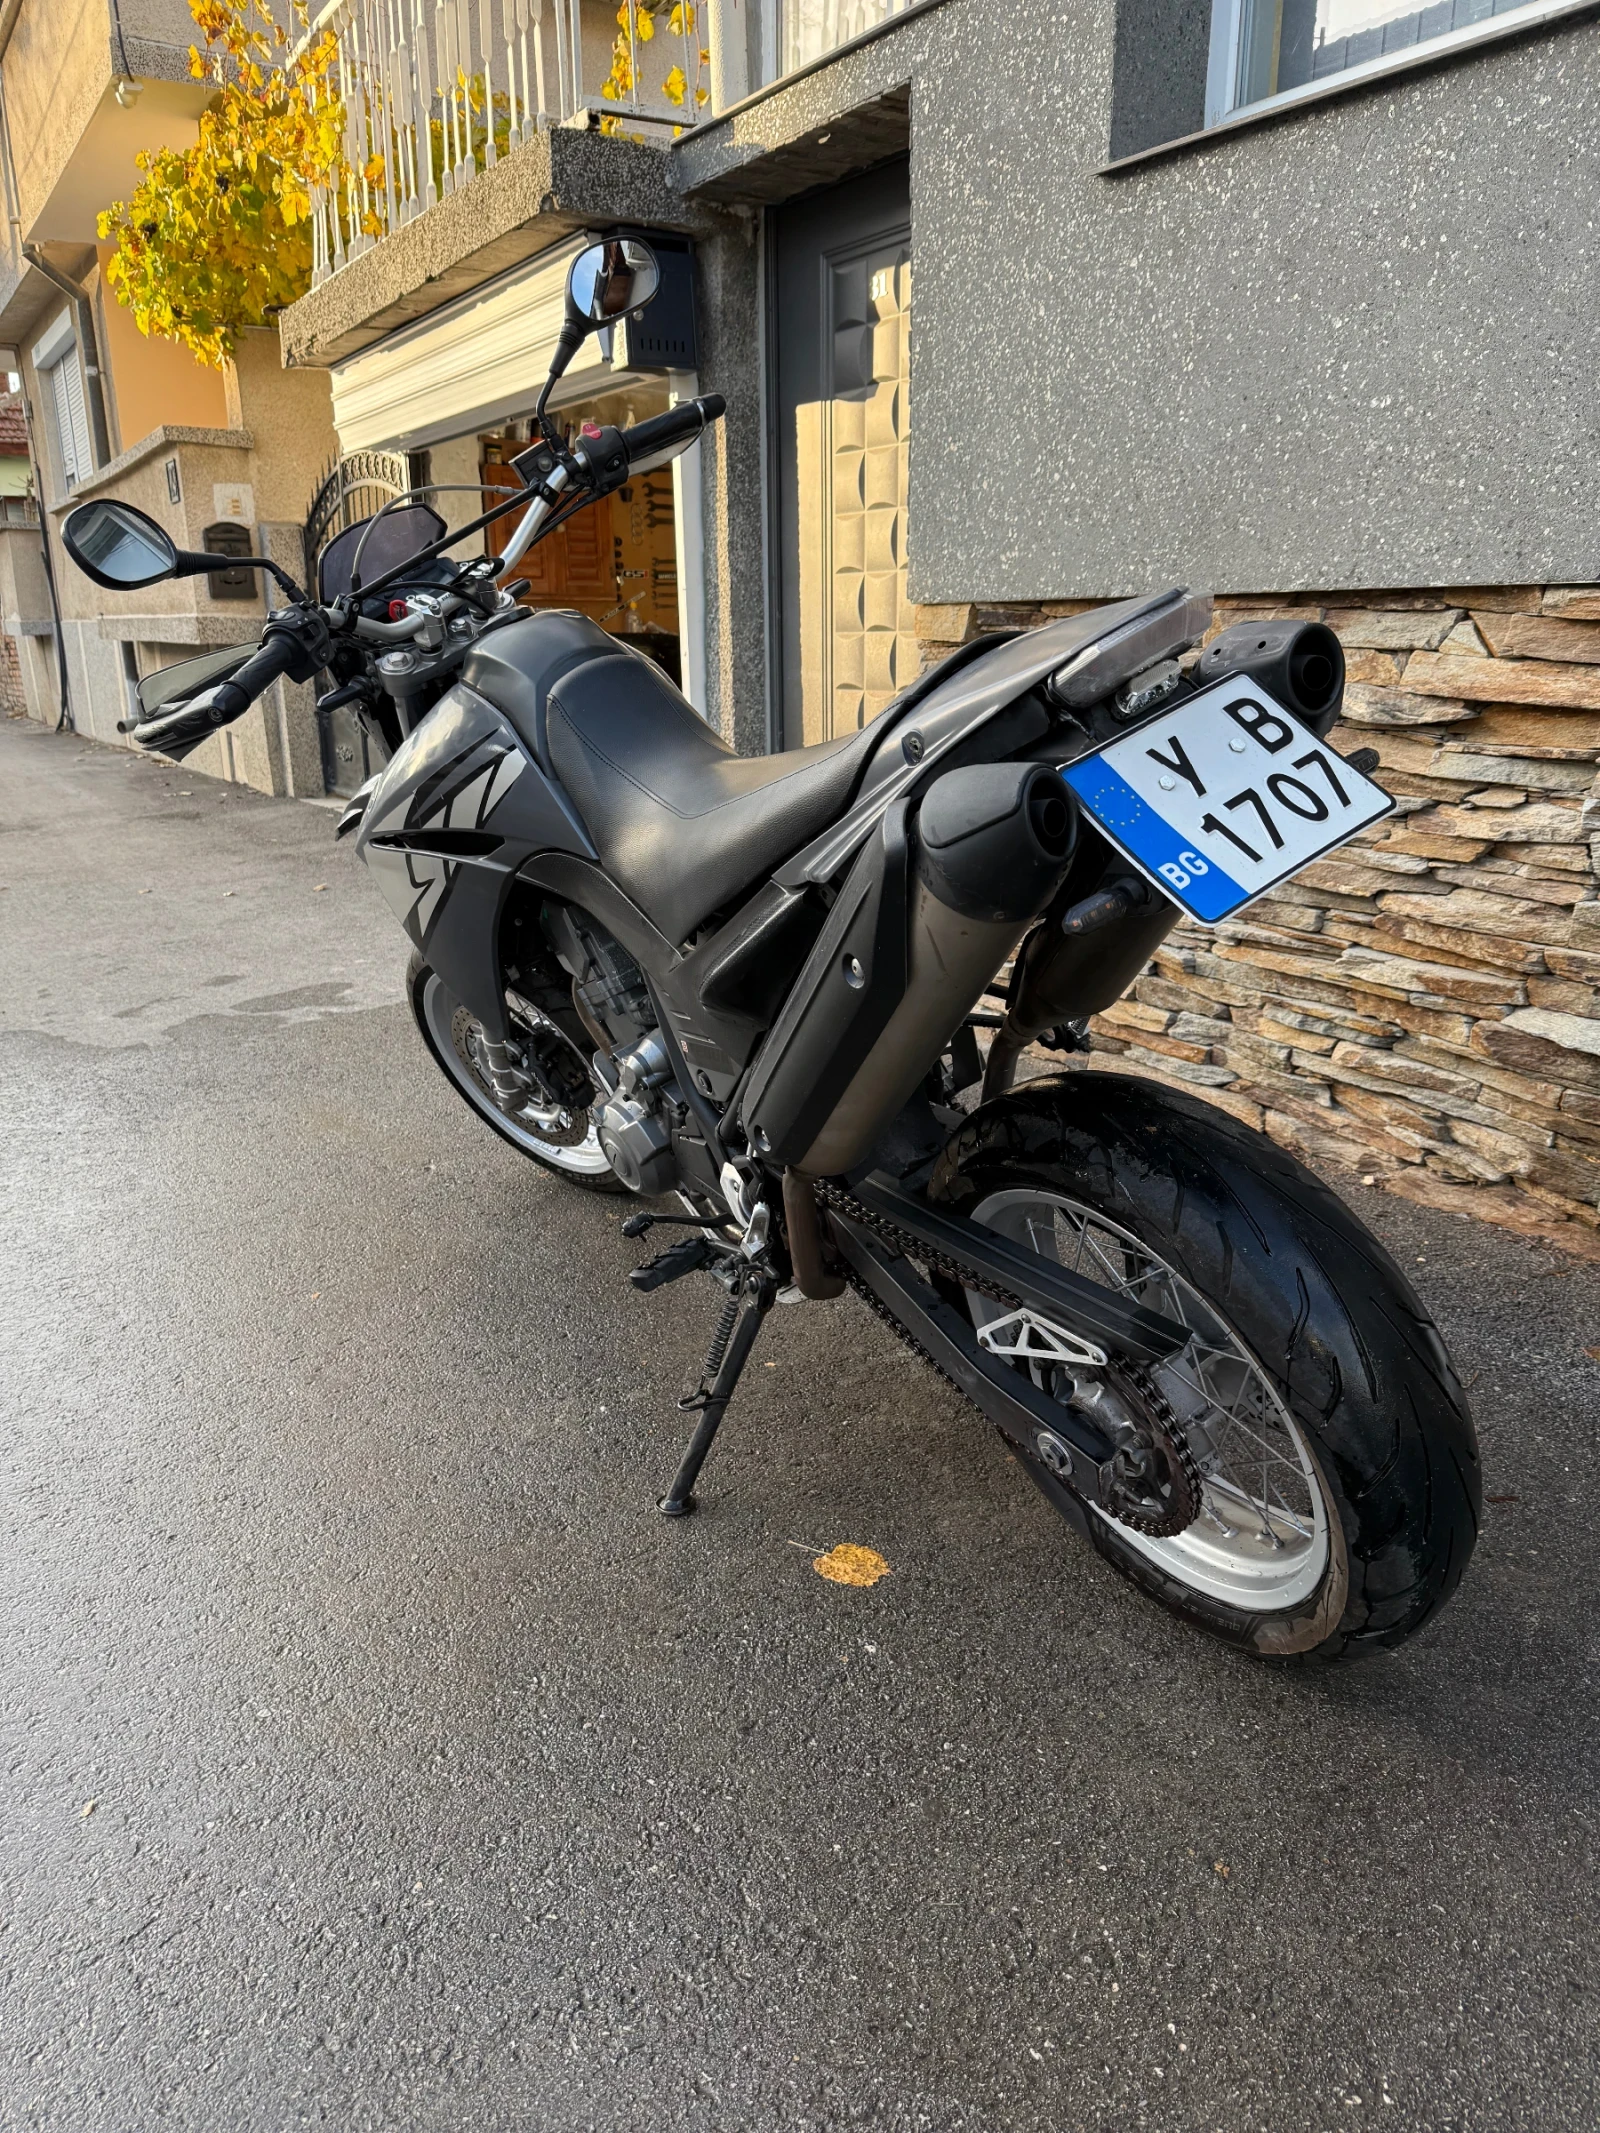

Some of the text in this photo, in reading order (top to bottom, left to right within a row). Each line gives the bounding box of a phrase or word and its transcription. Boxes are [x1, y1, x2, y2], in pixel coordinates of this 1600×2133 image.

[1146, 697, 1294, 798] Y B
[1200, 749, 1352, 864] 1707
[1157, 851, 1210, 890] BG
